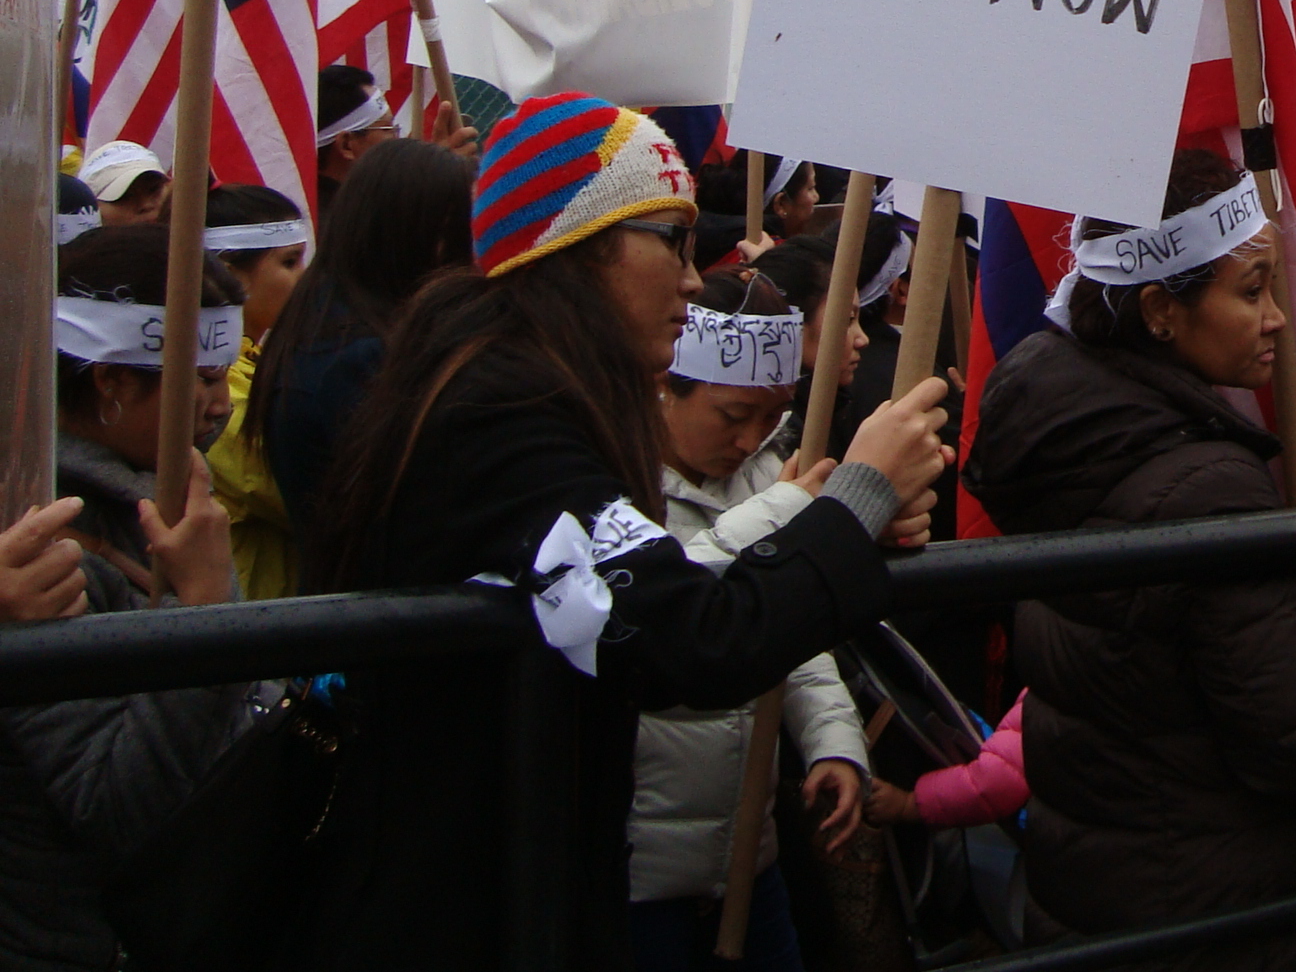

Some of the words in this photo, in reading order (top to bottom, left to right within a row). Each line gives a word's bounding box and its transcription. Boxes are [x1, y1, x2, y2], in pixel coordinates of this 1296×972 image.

[263, 220, 294, 236] SAVE
[1115, 227, 1188, 275] SAVE
[141, 317, 229, 352] SVE
